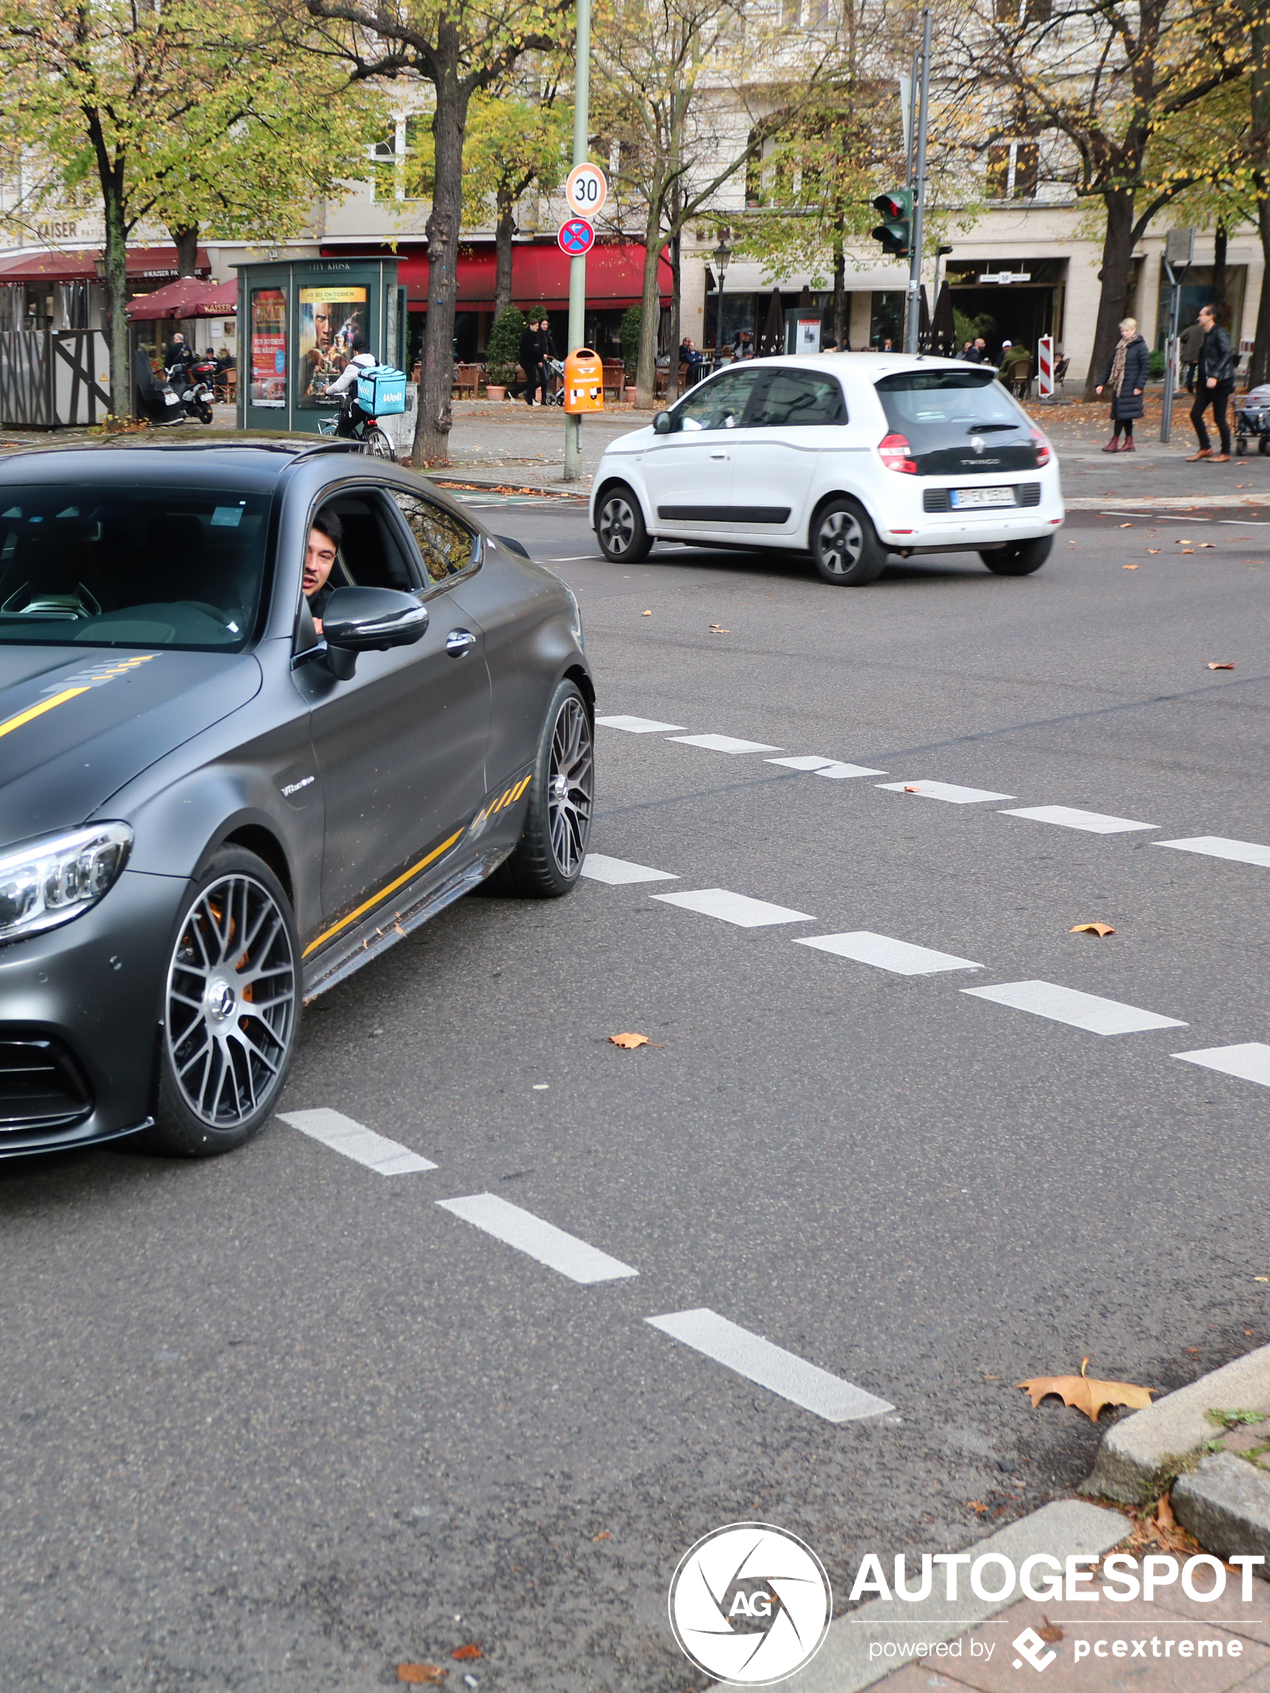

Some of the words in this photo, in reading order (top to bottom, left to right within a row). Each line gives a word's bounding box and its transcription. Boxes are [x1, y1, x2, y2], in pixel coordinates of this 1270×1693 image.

[575, 178, 598, 202] 30
[37, 221, 77, 239] KAISER
[327, 261, 351, 271] KIOSK
[203, 303, 232, 313] KAISER
[383, 391, 402, 402] Wolt
